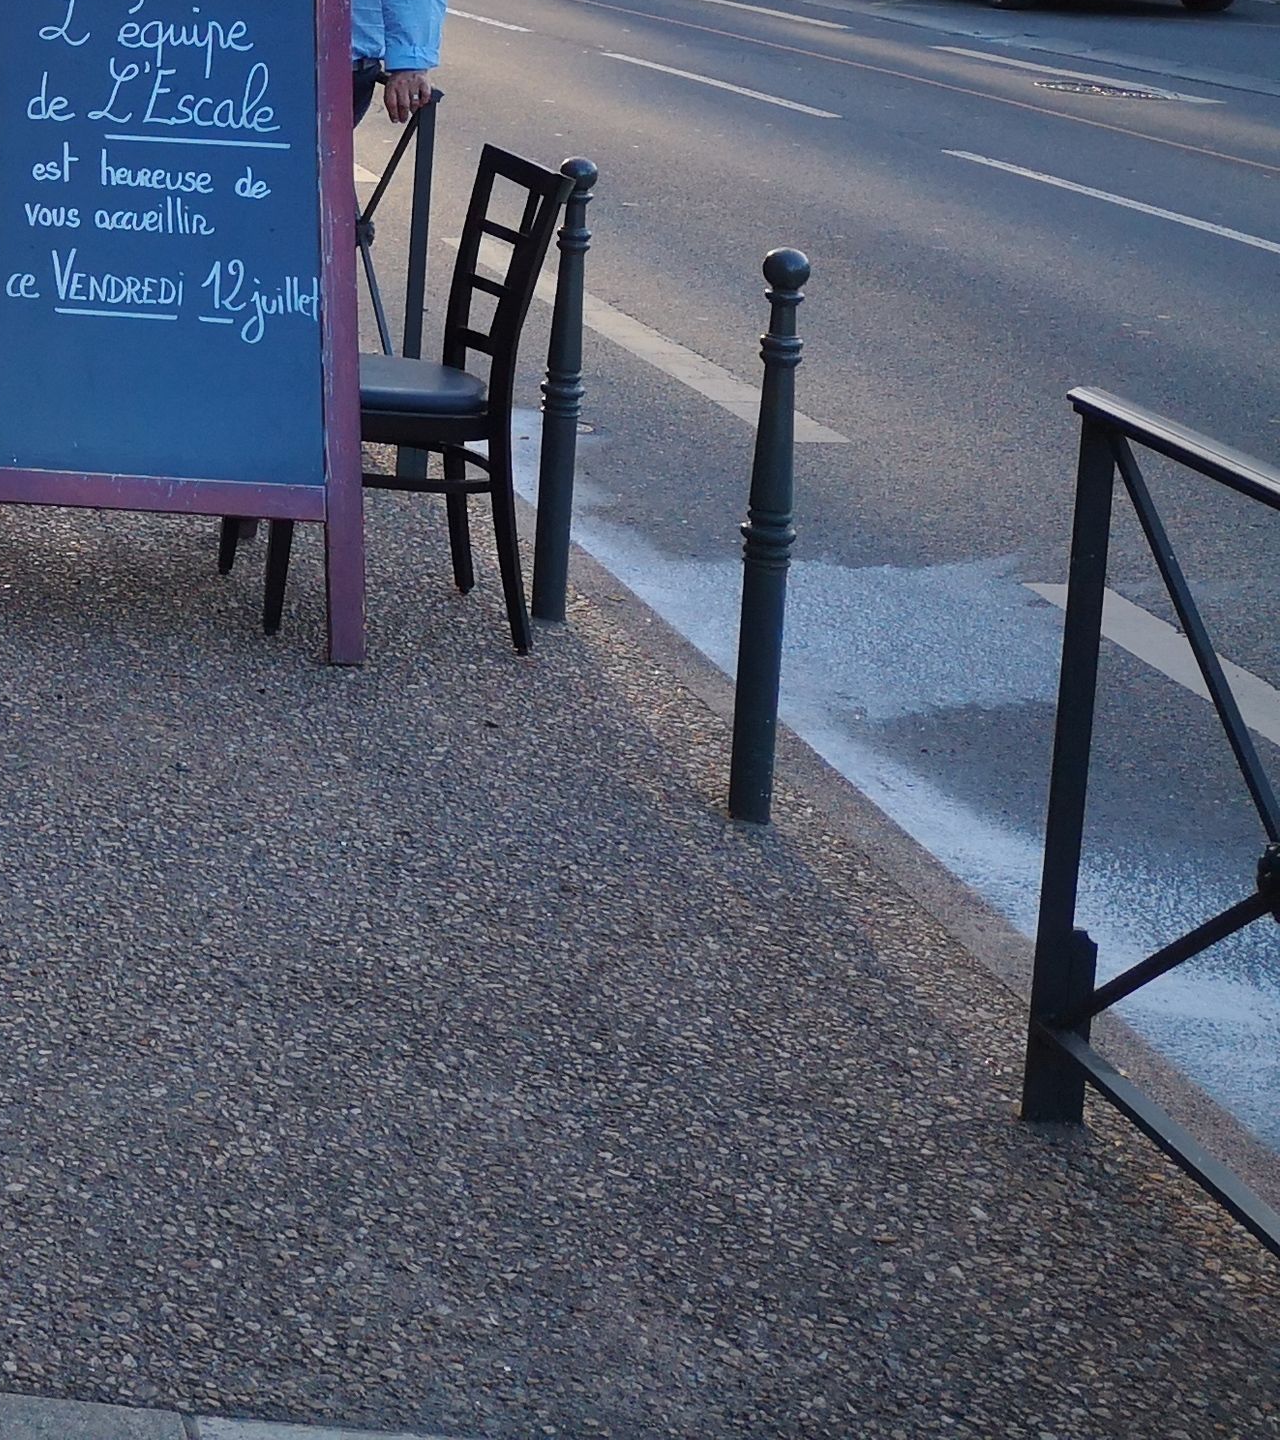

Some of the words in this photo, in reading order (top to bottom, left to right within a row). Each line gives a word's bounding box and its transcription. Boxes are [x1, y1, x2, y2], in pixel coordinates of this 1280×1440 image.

[26, 71, 76, 121] de
[87, 57, 280, 132] L'Escale
[32, 141, 79, 183] est
[100, 148, 214, 194] heureuse
[235, 166, 272, 200] de
[94, 196, 215, 235] accueillir
[6, 271, 40, 300] ce
[200, 259, 246, 311] 12
[241, 277, 319, 344] juillet
